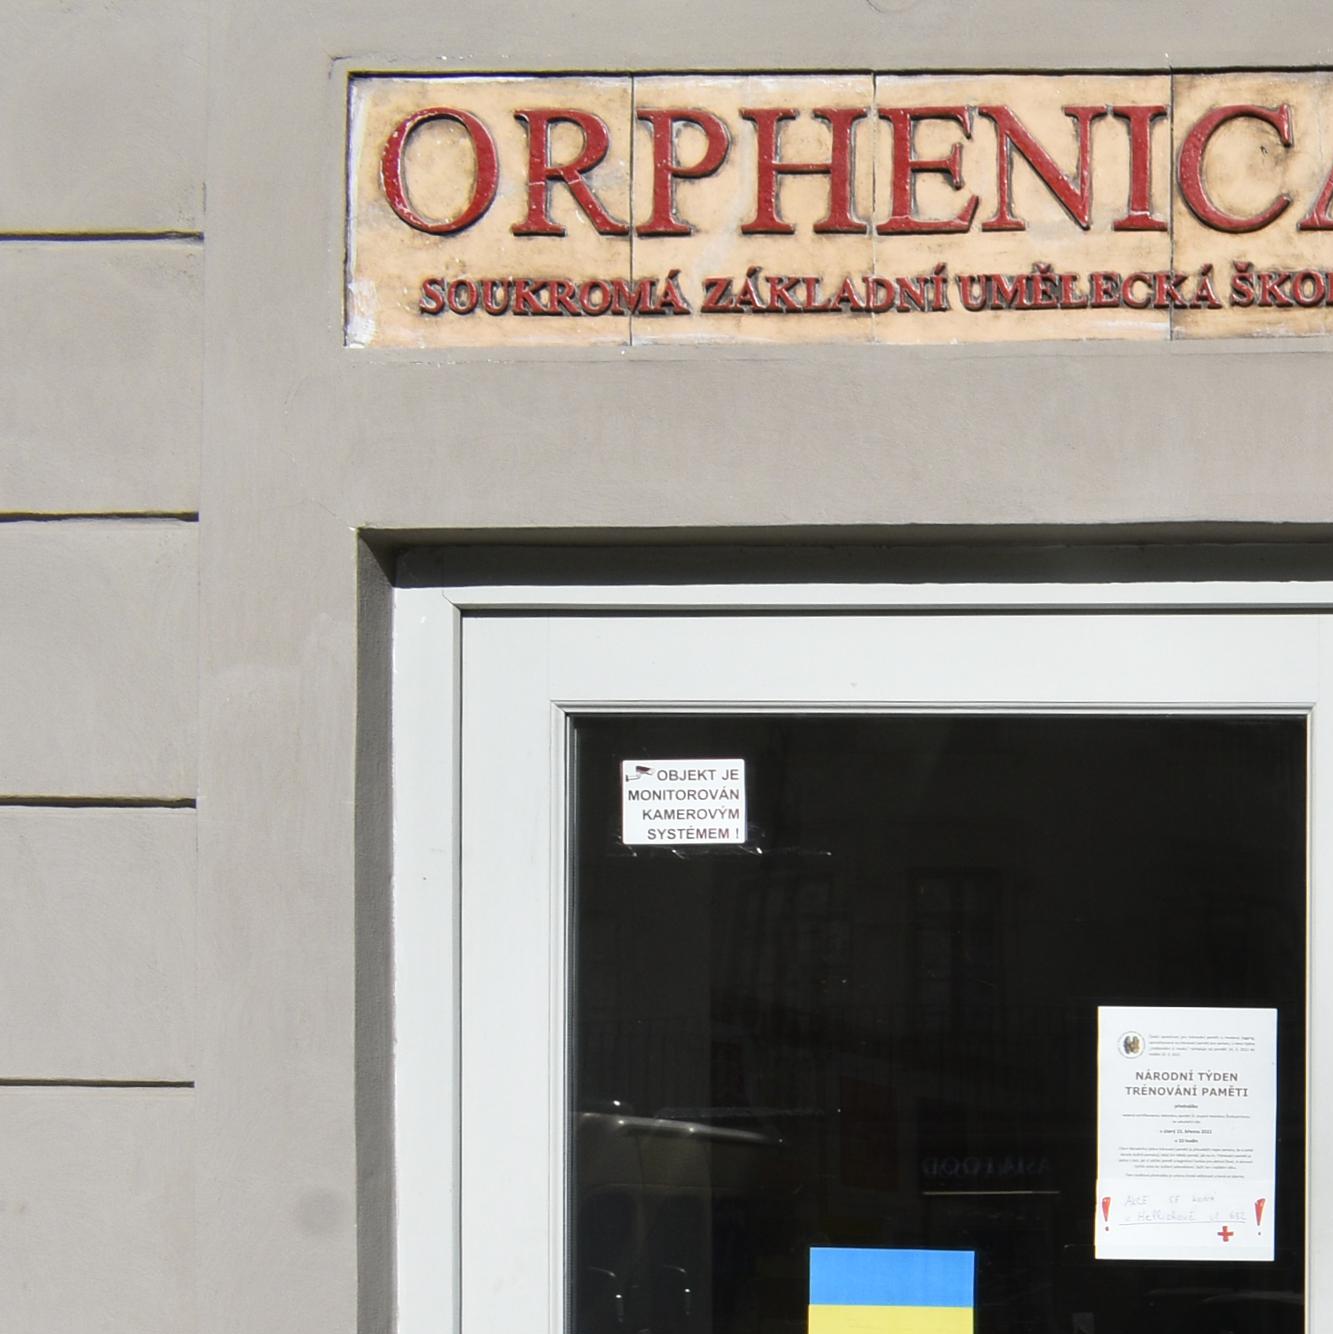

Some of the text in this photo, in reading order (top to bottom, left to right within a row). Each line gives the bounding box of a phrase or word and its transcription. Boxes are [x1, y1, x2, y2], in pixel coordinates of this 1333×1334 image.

[419, 268, 692, 317] SOUKROMÁ
[700, 263, 950, 314] ZÁKLADNÍ
[956, 261, 1223, 312] UMĚLECKÁ
[657, 768, 740, 782] OBJEKT JE
[628, 786, 740, 801] MONITOROVÁN
[642, 805, 740, 820] KAMEROVÝM
[647, 825, 730, 840] SYSTÉMEM
[1135, 1068, 1238, 1082] NÁRODNÍ TÝDEN
[1124, 1083, 1249, 1098] TRÉNOVÁNÍ PAMĚTI
